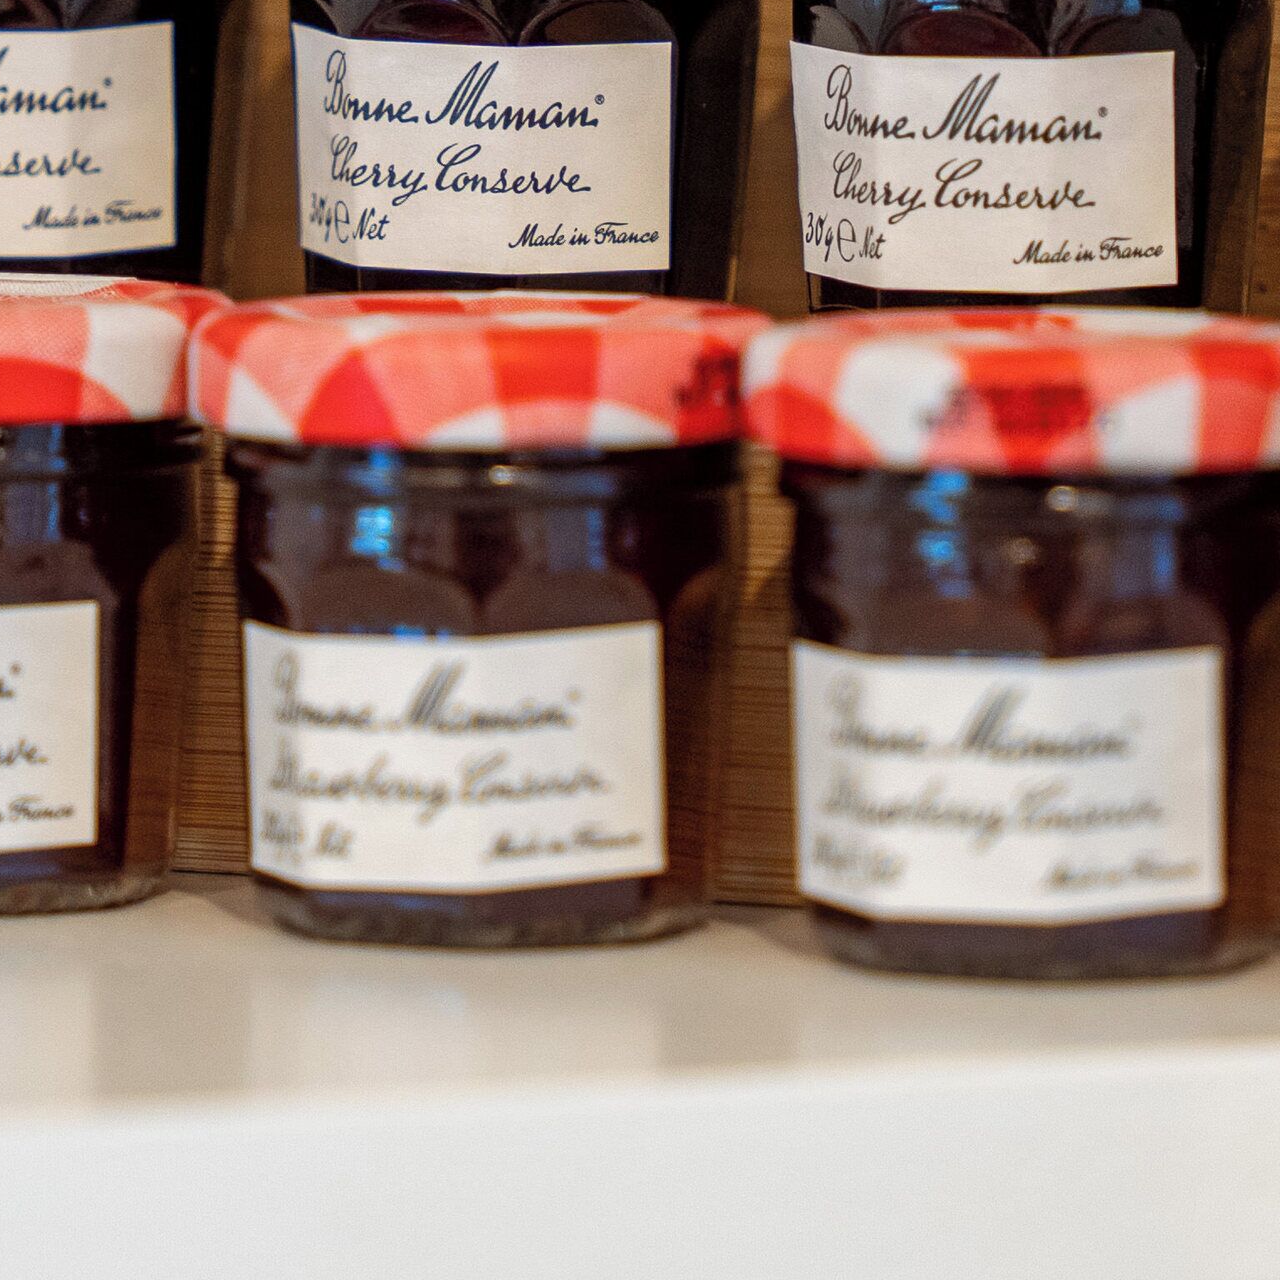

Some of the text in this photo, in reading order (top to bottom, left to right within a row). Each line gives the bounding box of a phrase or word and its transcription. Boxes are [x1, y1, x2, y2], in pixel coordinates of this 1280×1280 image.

[324, 49, 419, 120] Bonne
[824, 64, 915, 141] Bonne
[331, 133, 592, 207] Cherry Conserve
[832, 150, 1097, 226] Cherry Conserve
[352, 207, 391, 240] Net
[508, 221, 660, 250] Made in France
[858, 226, 887, 261] Net
[1012, 236, 1165, 265] Made in France
